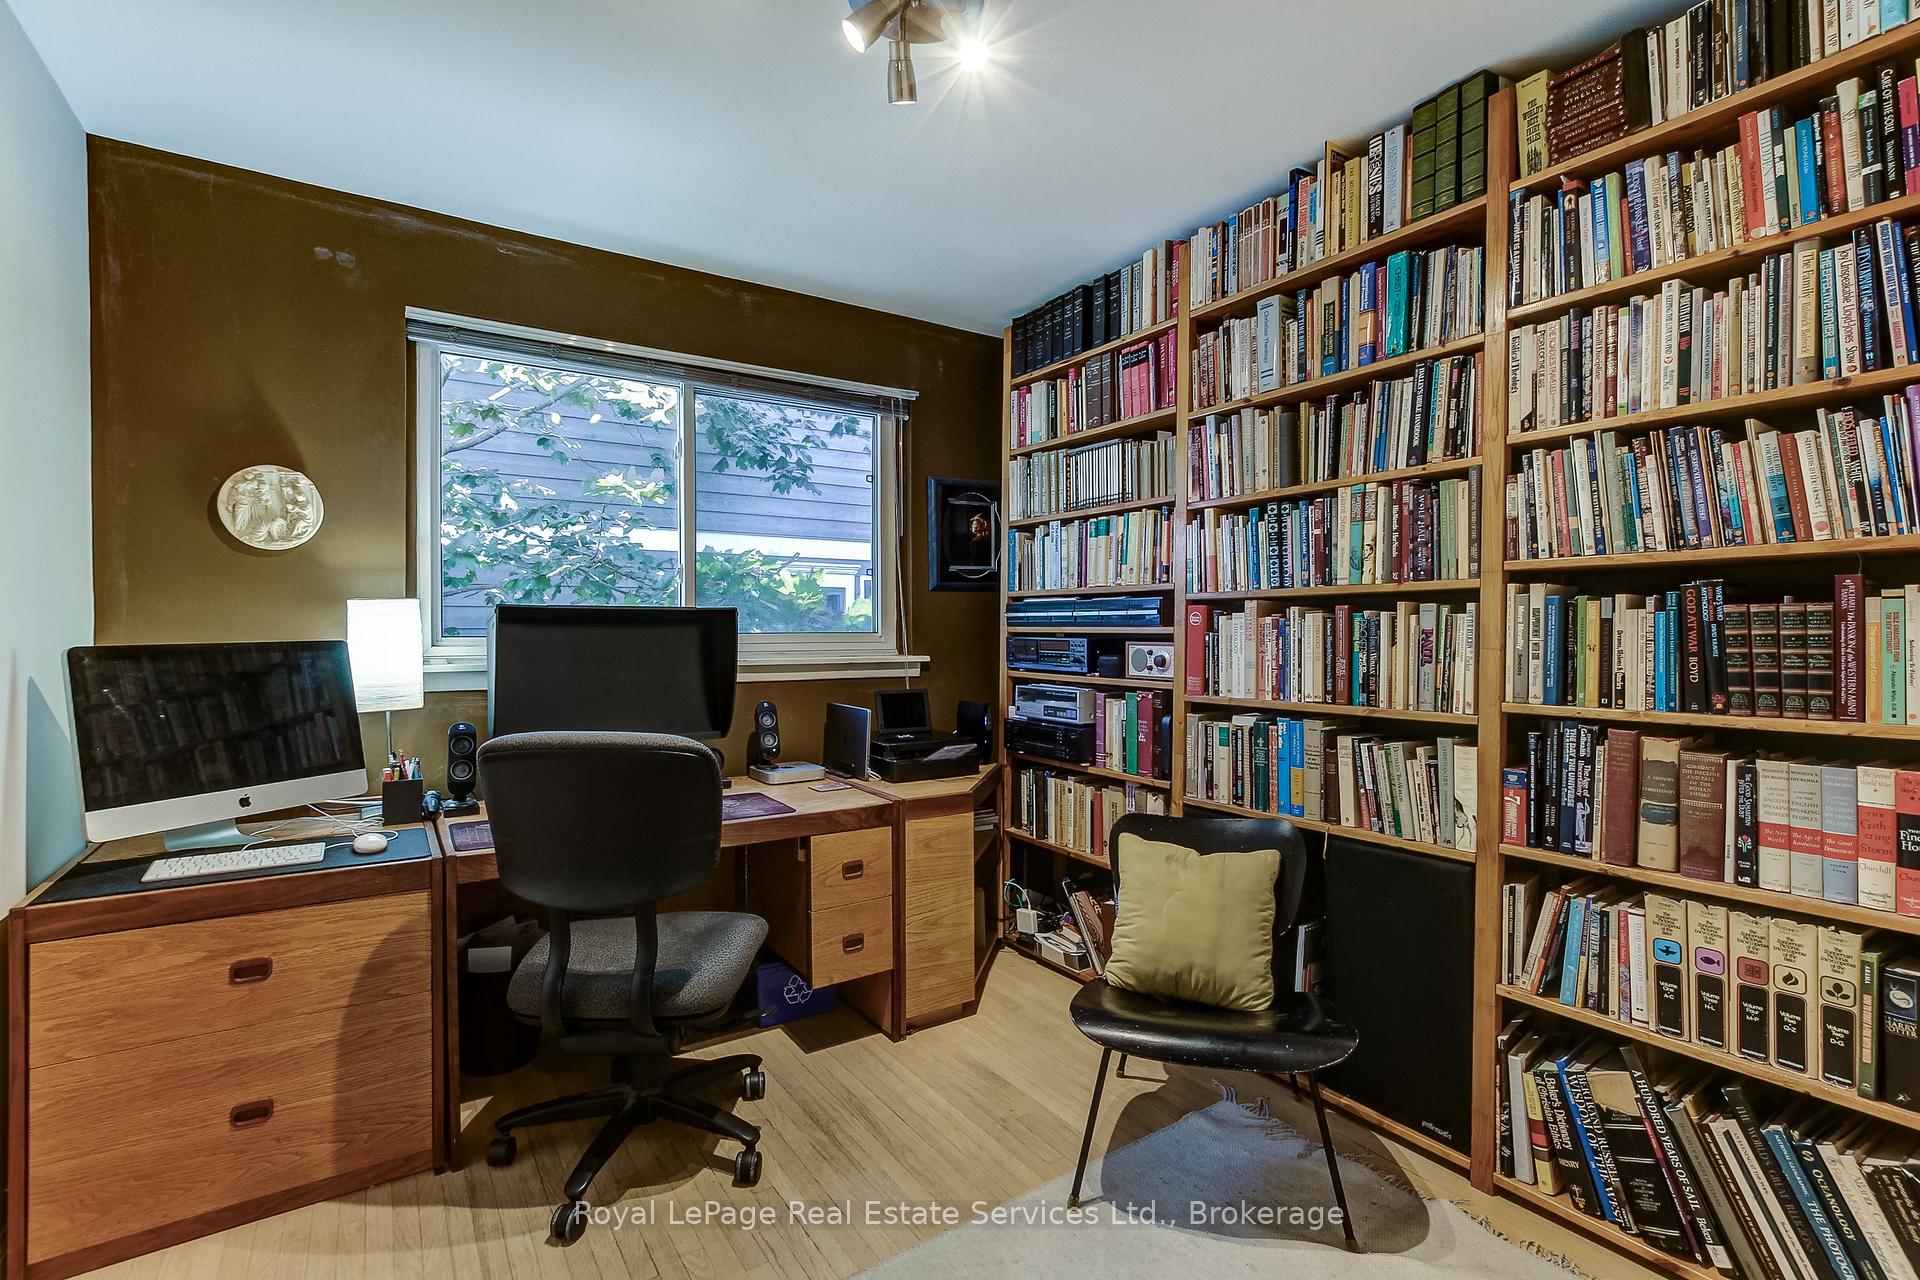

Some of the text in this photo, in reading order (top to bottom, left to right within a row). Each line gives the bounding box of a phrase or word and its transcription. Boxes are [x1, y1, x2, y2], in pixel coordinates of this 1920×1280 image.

[1827, 34, 1837, 47] IVP
[1564, 85, 1602, 106] OTHELLO
[1881, 69, 1894, 135] CARE OF THE SOUL
[1802, 252, 1813, 269] The
[1799, 270, 1813, 299] Family
[1821, 252, 1834, 338] THE EFFECTIVE FATHER
[1838, 247, 1857, 364] Joy Unspeakable Lloyd-Jones Shaw
[1594, 309, 1603, 380] Home Built Discipline
[1510, 336, 1521, 394] Biblical Theology
[1413, 368, 1425, 447] HALLEY'S BIBLE HANDBOOK
[1850, 460, 1862, 482] WHITE
[1860, 521, 1870, 532] IVP
[1339, 516, 1347, 539] Steps
[1417, 495, 1426, 542] WOLF HALL
[1701, 586, 1709, 622] MYTHOLOGY
[1715, 586, 1723, 605] WHO'S
[1840, 588, 1848, 609] TARNAS
[1848, 586, 1856, 610] RICHARD
[1517, 605, 1525, 622] Mere
[1847, 612, 1855, 621] The
[1421, 628, 1434, 667] PAUL
[1516, 623, 1525, 649] Morality
[1615, 630, 1624, 649] Dreams,
[1686, 589, 1699, 683] GOD AT WAR BOYD
[1847, 622, 1856, 648] PASSION
[1847, 661, 1856, 694] WESTERN
[1848, 695, 1856, 715] MIND
[1579, 728, 1587, 757] Galbraith
[1568, 758, 1576, 771] THE
[1567, 772, 1575, 807] UNIVERSE
[1582, 776, 1590, 786] Age
[1583, 788, 1590, 797] of
[1504, 796, 1520, 804] 7
[1860, 819, 1891, 830] Gath-
[1792, 840, 1821, 849] Revolution
[1803, 834, 1813, 842] Age
[1824, 846, 1856, 855] Democracies
[1835, 839, 1853, 847] Great
[1860, 843, 1892, 855] Storm
[1859, 862, 1891, 874] Churchill
[1631, 1069, 1642, 1077] A
[1544, 1072, 1573, 1150] Baker's Dictionary
[1636, 1079, 1667, 1135] HUNDRED
[1548, 1123, 1561, 1149] Ethics
[1577, 1074, 1620, 1184] BERTRAND RUSSELL
[1567, 1075, 1625, 1227] WISDOM OF THE WEST
[1659, 1136, 1682, 1168] YEARS
[1676, 1167, 1689, 1185] OF
[1774, 1134, 1792, 1163] NATIONAL
[1807, 1200, 1826, 1225] THE
[1682, 1183, 1701, 1211] SAIL
[1812, 1169, 1857, 1242] OCEANOLOGY
